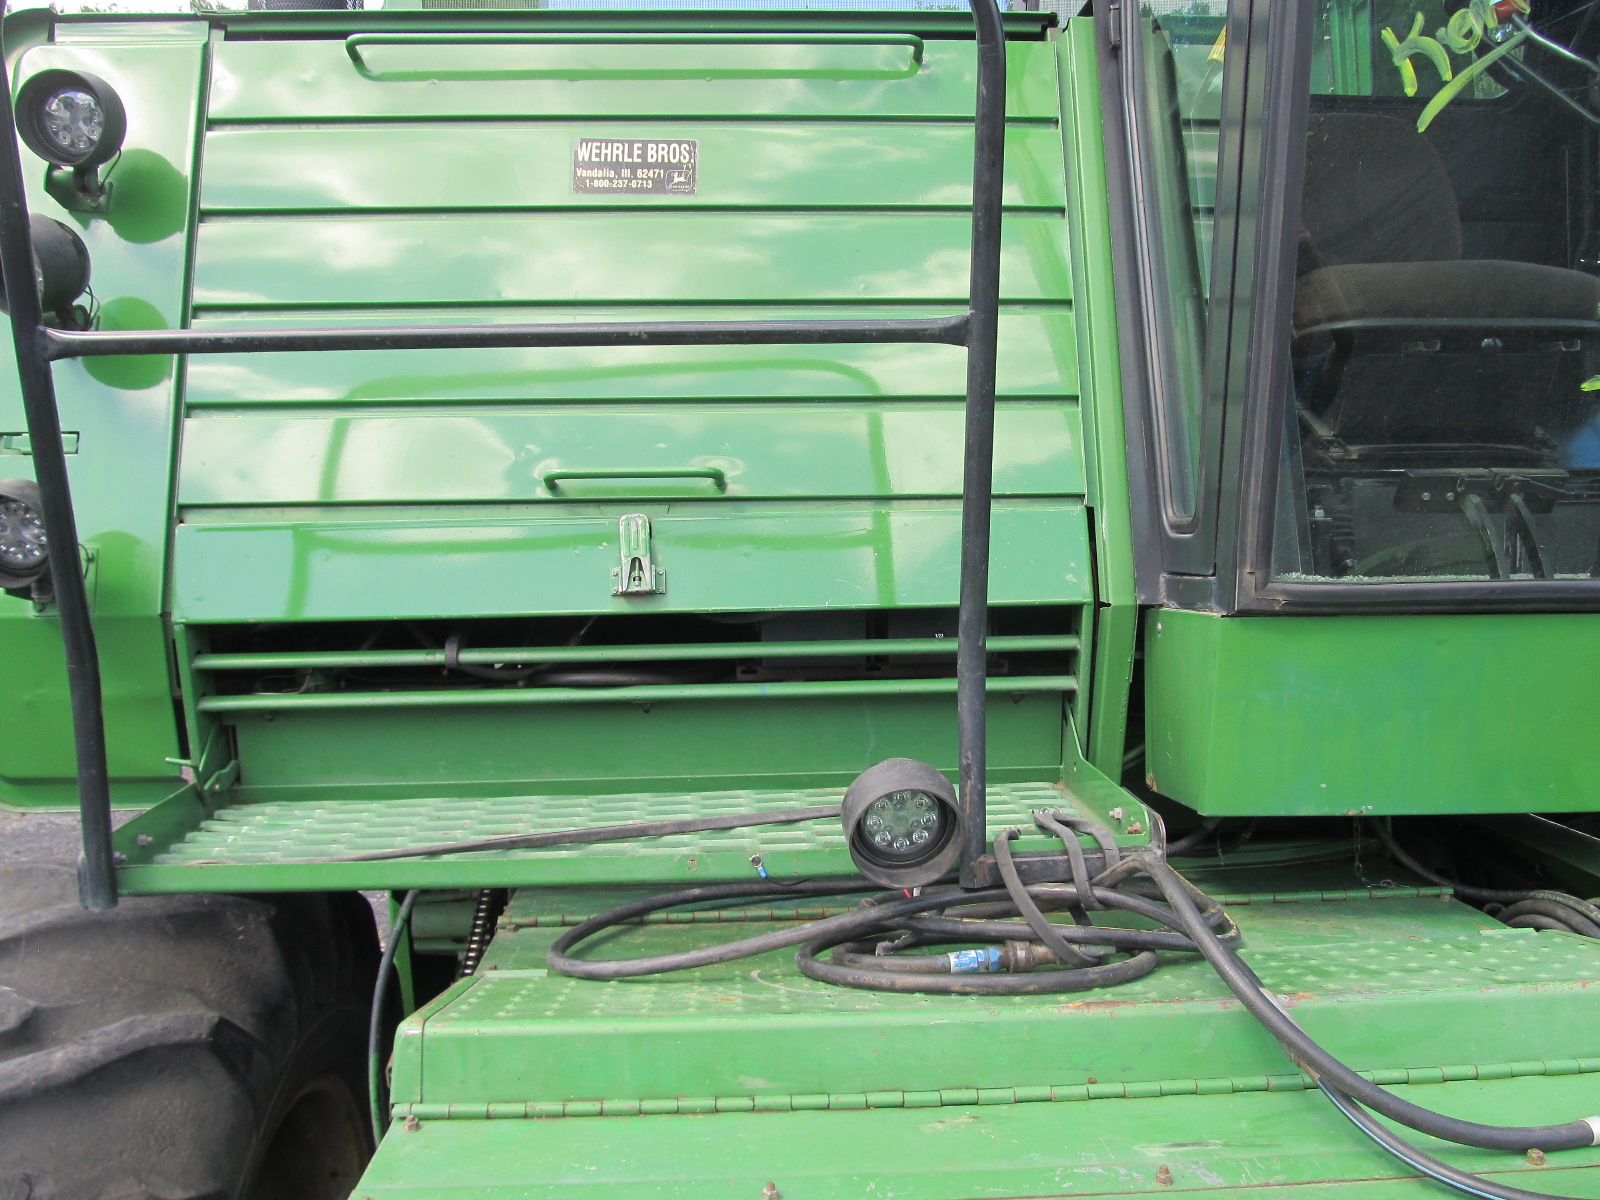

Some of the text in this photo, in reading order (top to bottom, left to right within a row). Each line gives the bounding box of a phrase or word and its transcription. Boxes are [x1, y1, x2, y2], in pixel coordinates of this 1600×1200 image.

[577, 141, 642, 163] WEHRLE
[576, 168, 618, 179] Vandalia,
[637, 169, 664, 178] 62471
[585, 179, 653, 188] 1-800-237-0713
